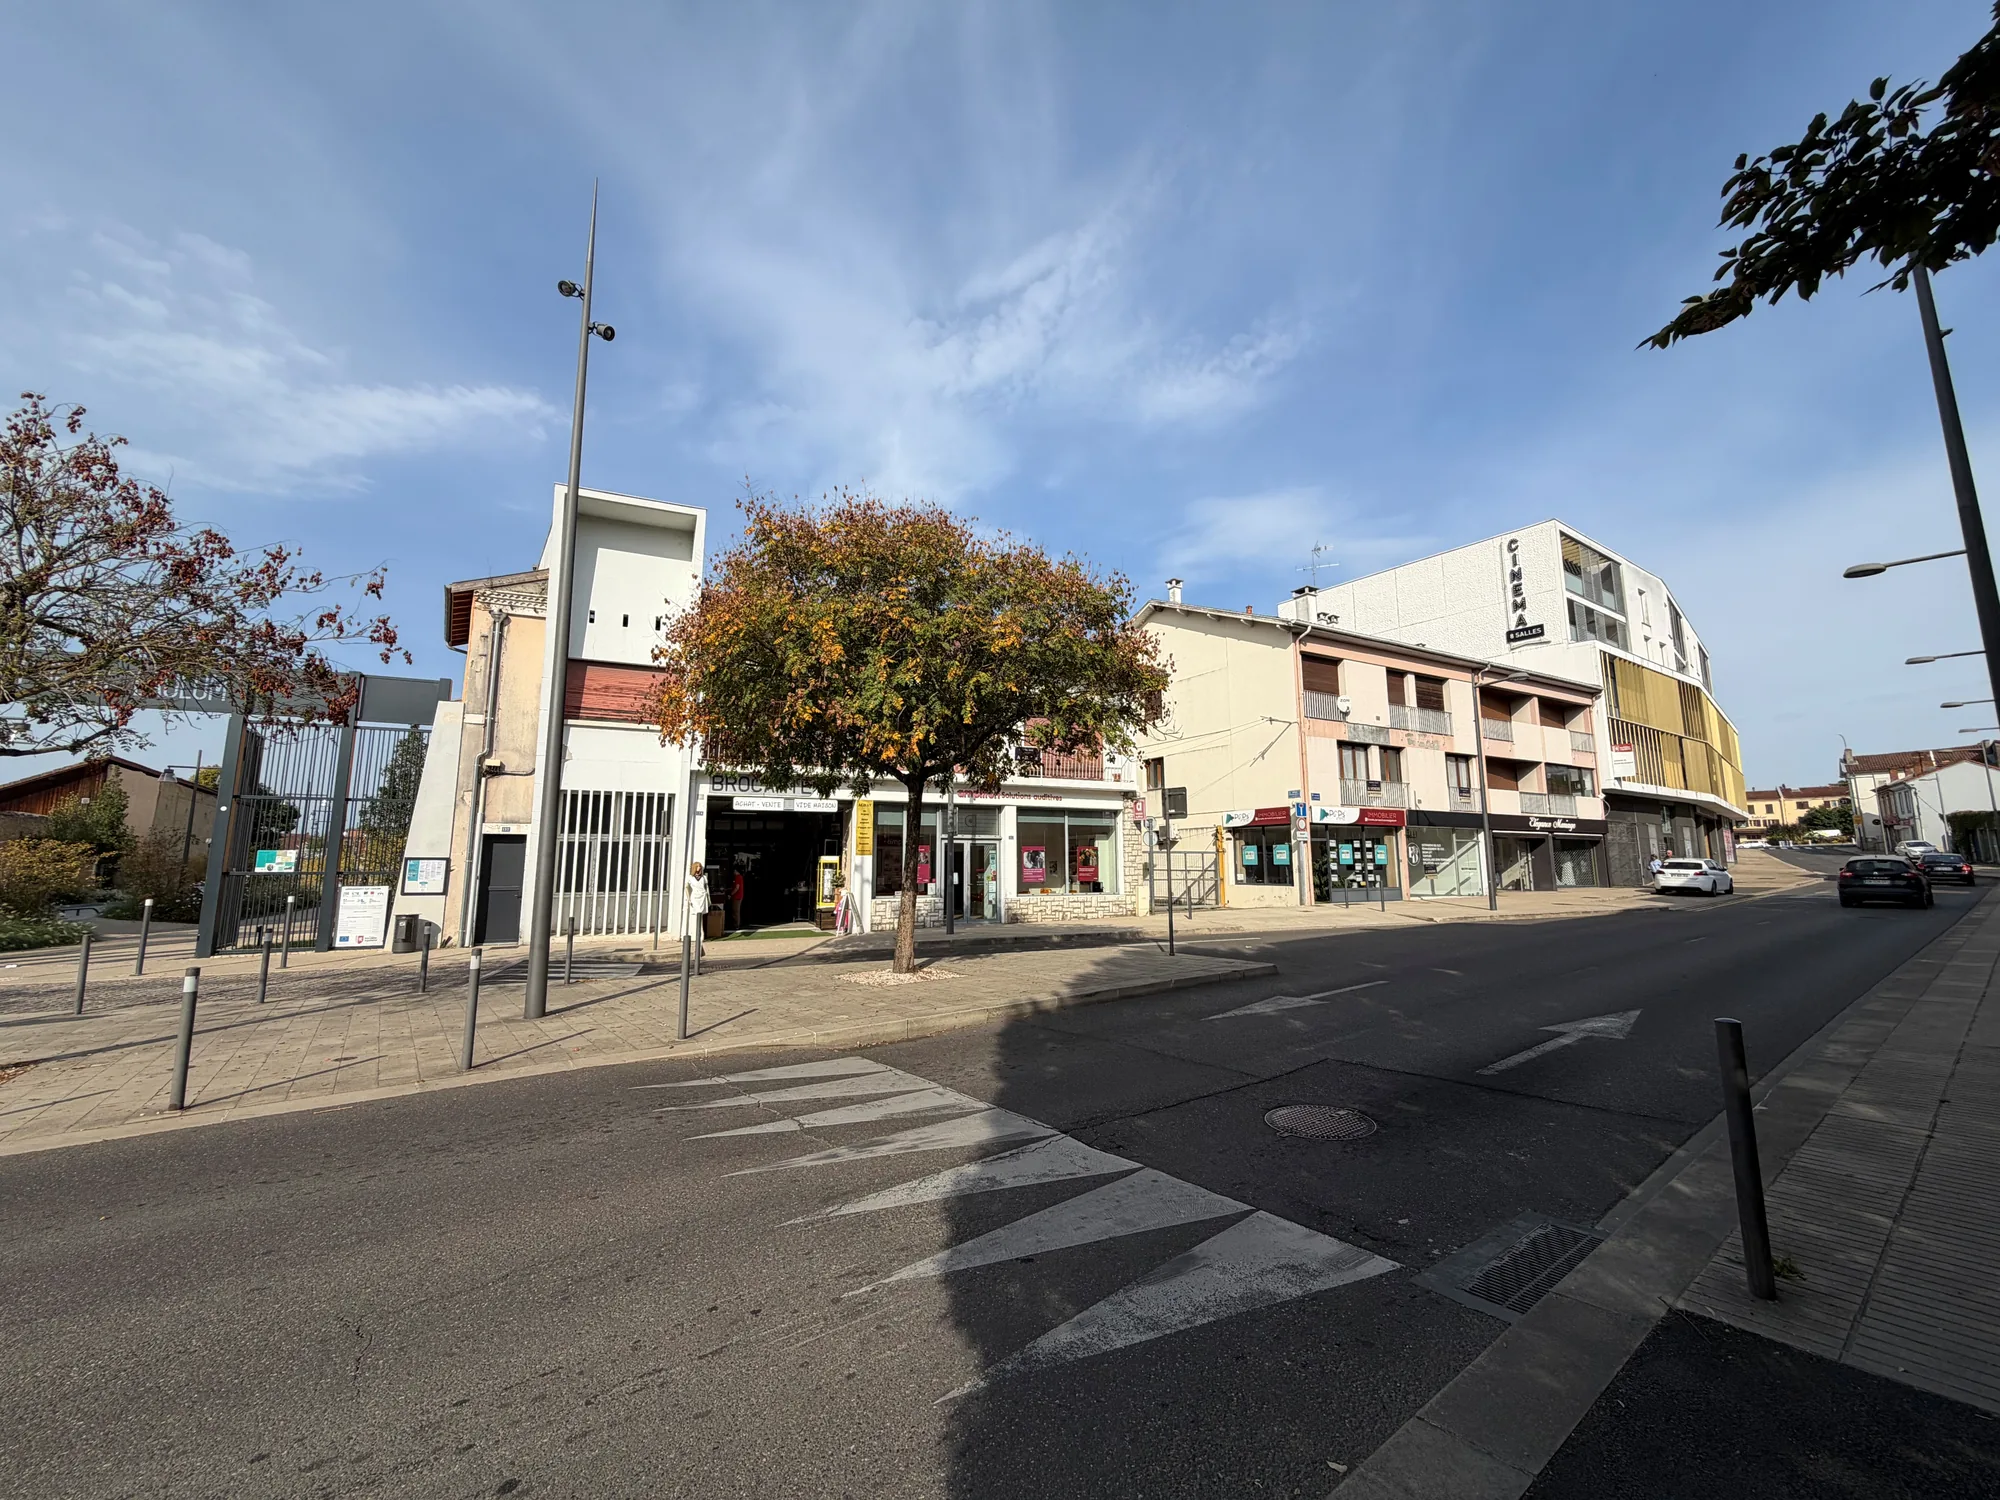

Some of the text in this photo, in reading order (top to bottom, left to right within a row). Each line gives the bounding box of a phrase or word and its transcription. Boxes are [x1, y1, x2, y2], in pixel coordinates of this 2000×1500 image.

[1507, 538, 1527, 628] CINEMA
[1515, 627, 1542, 638] SALLES
[711, 775, 812, 795] BROCE
[1001, 791, 1032, 800] Solutions
[1033, 793, 1063, 802] auditives
